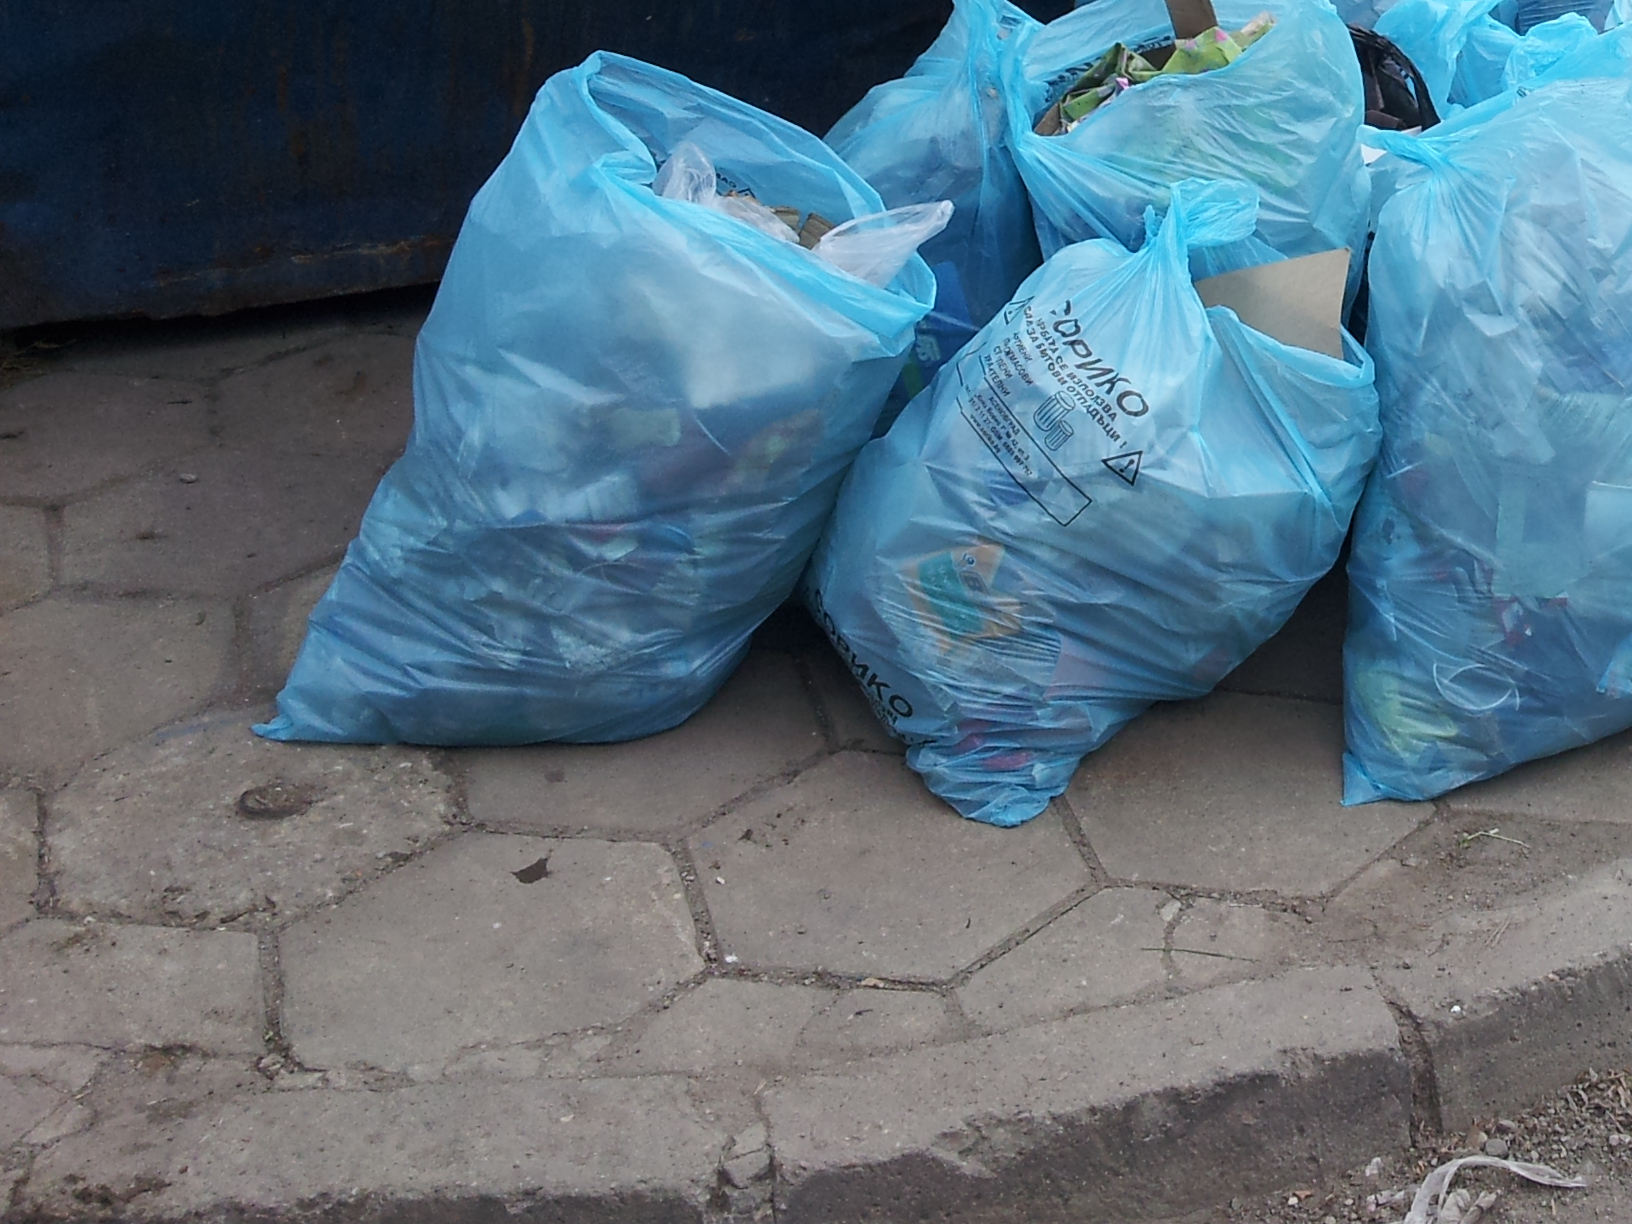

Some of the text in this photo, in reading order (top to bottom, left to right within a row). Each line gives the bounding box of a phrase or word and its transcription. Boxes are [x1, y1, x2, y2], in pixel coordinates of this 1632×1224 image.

[1055, 354, 1069, 371] СЕ
[1066, 371, 1118, 422] ИЗПОЛЗВА
[1066, 384, 1121, 443] ОТПАДЪЦИ
